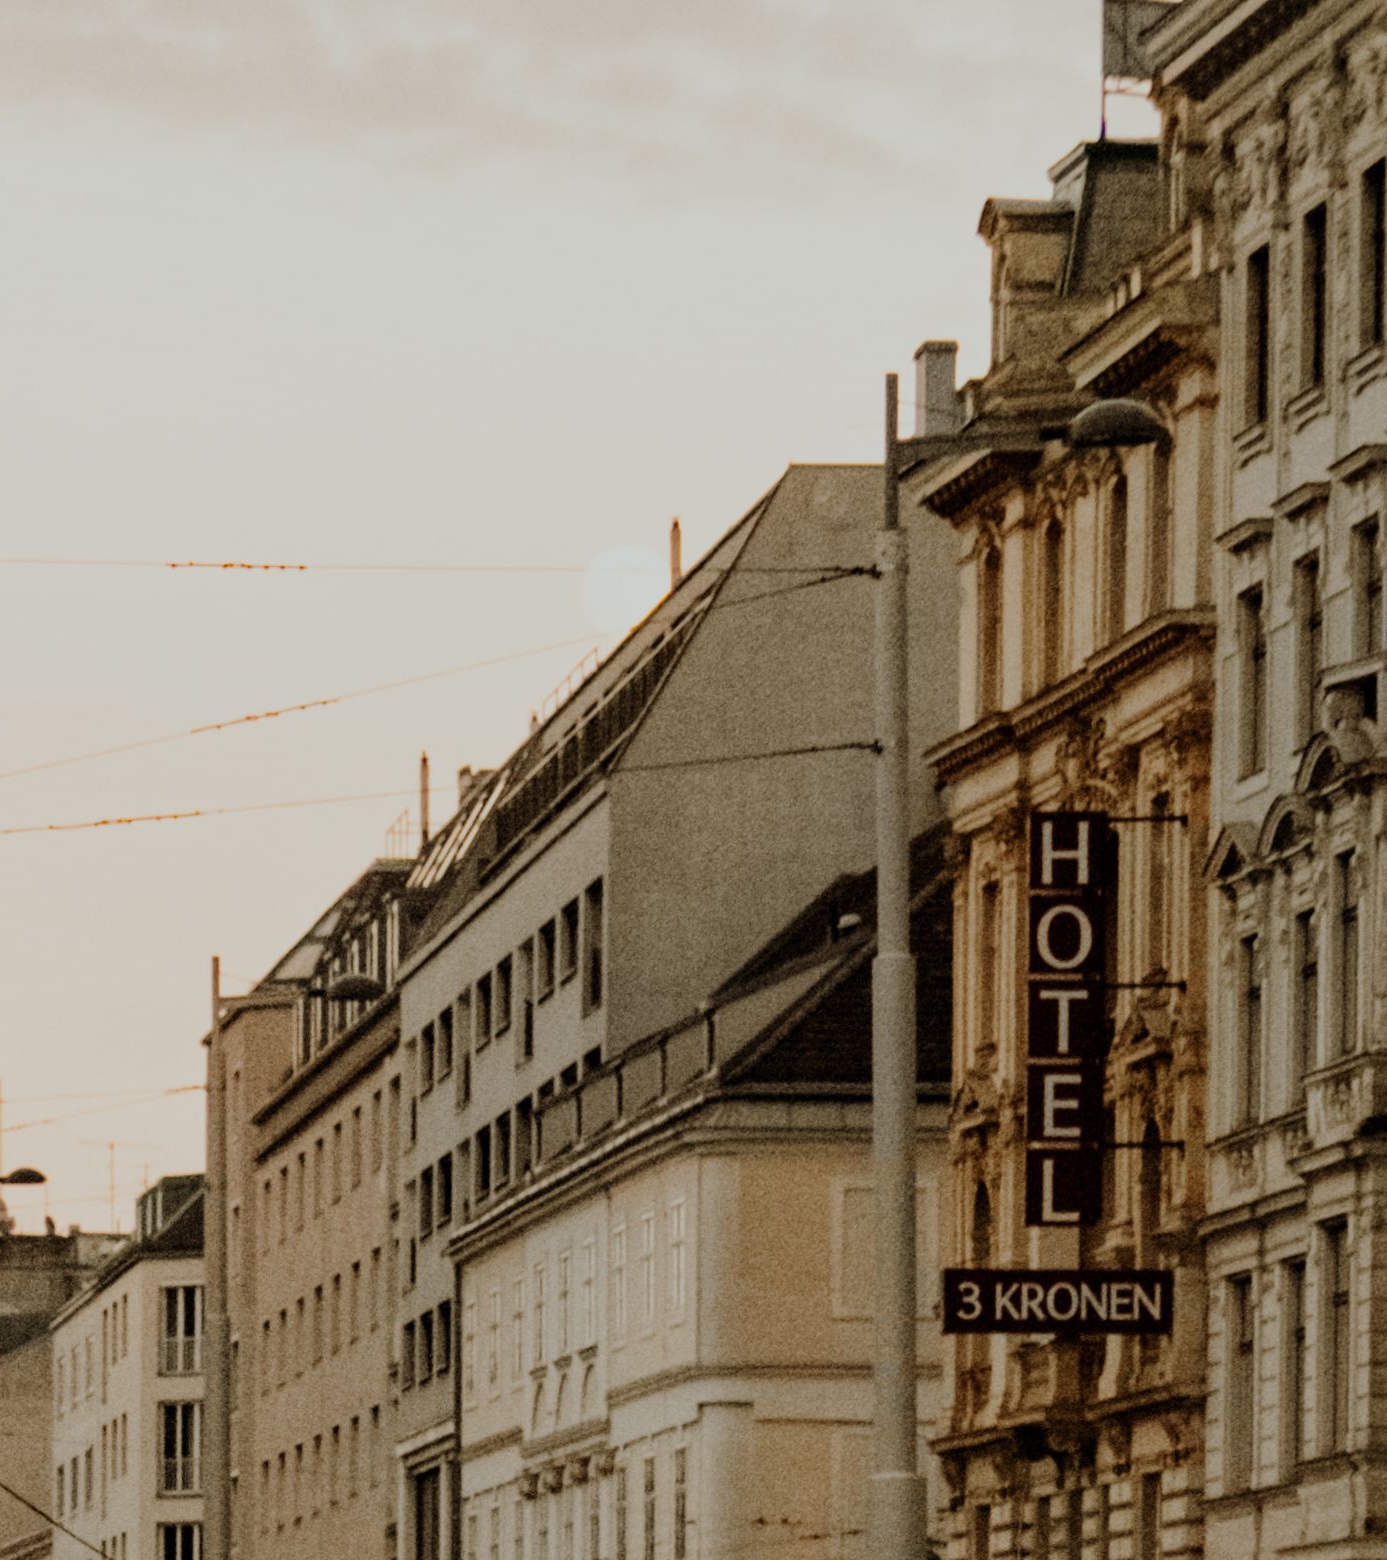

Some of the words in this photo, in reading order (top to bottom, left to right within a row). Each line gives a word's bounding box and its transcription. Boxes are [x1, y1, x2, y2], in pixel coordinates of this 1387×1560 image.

[1036, 820, 1093, 1224] HOTEL
[957, 1281, 982, 1322] 3
[995, 1281, 1163, 1322] KRONEN
